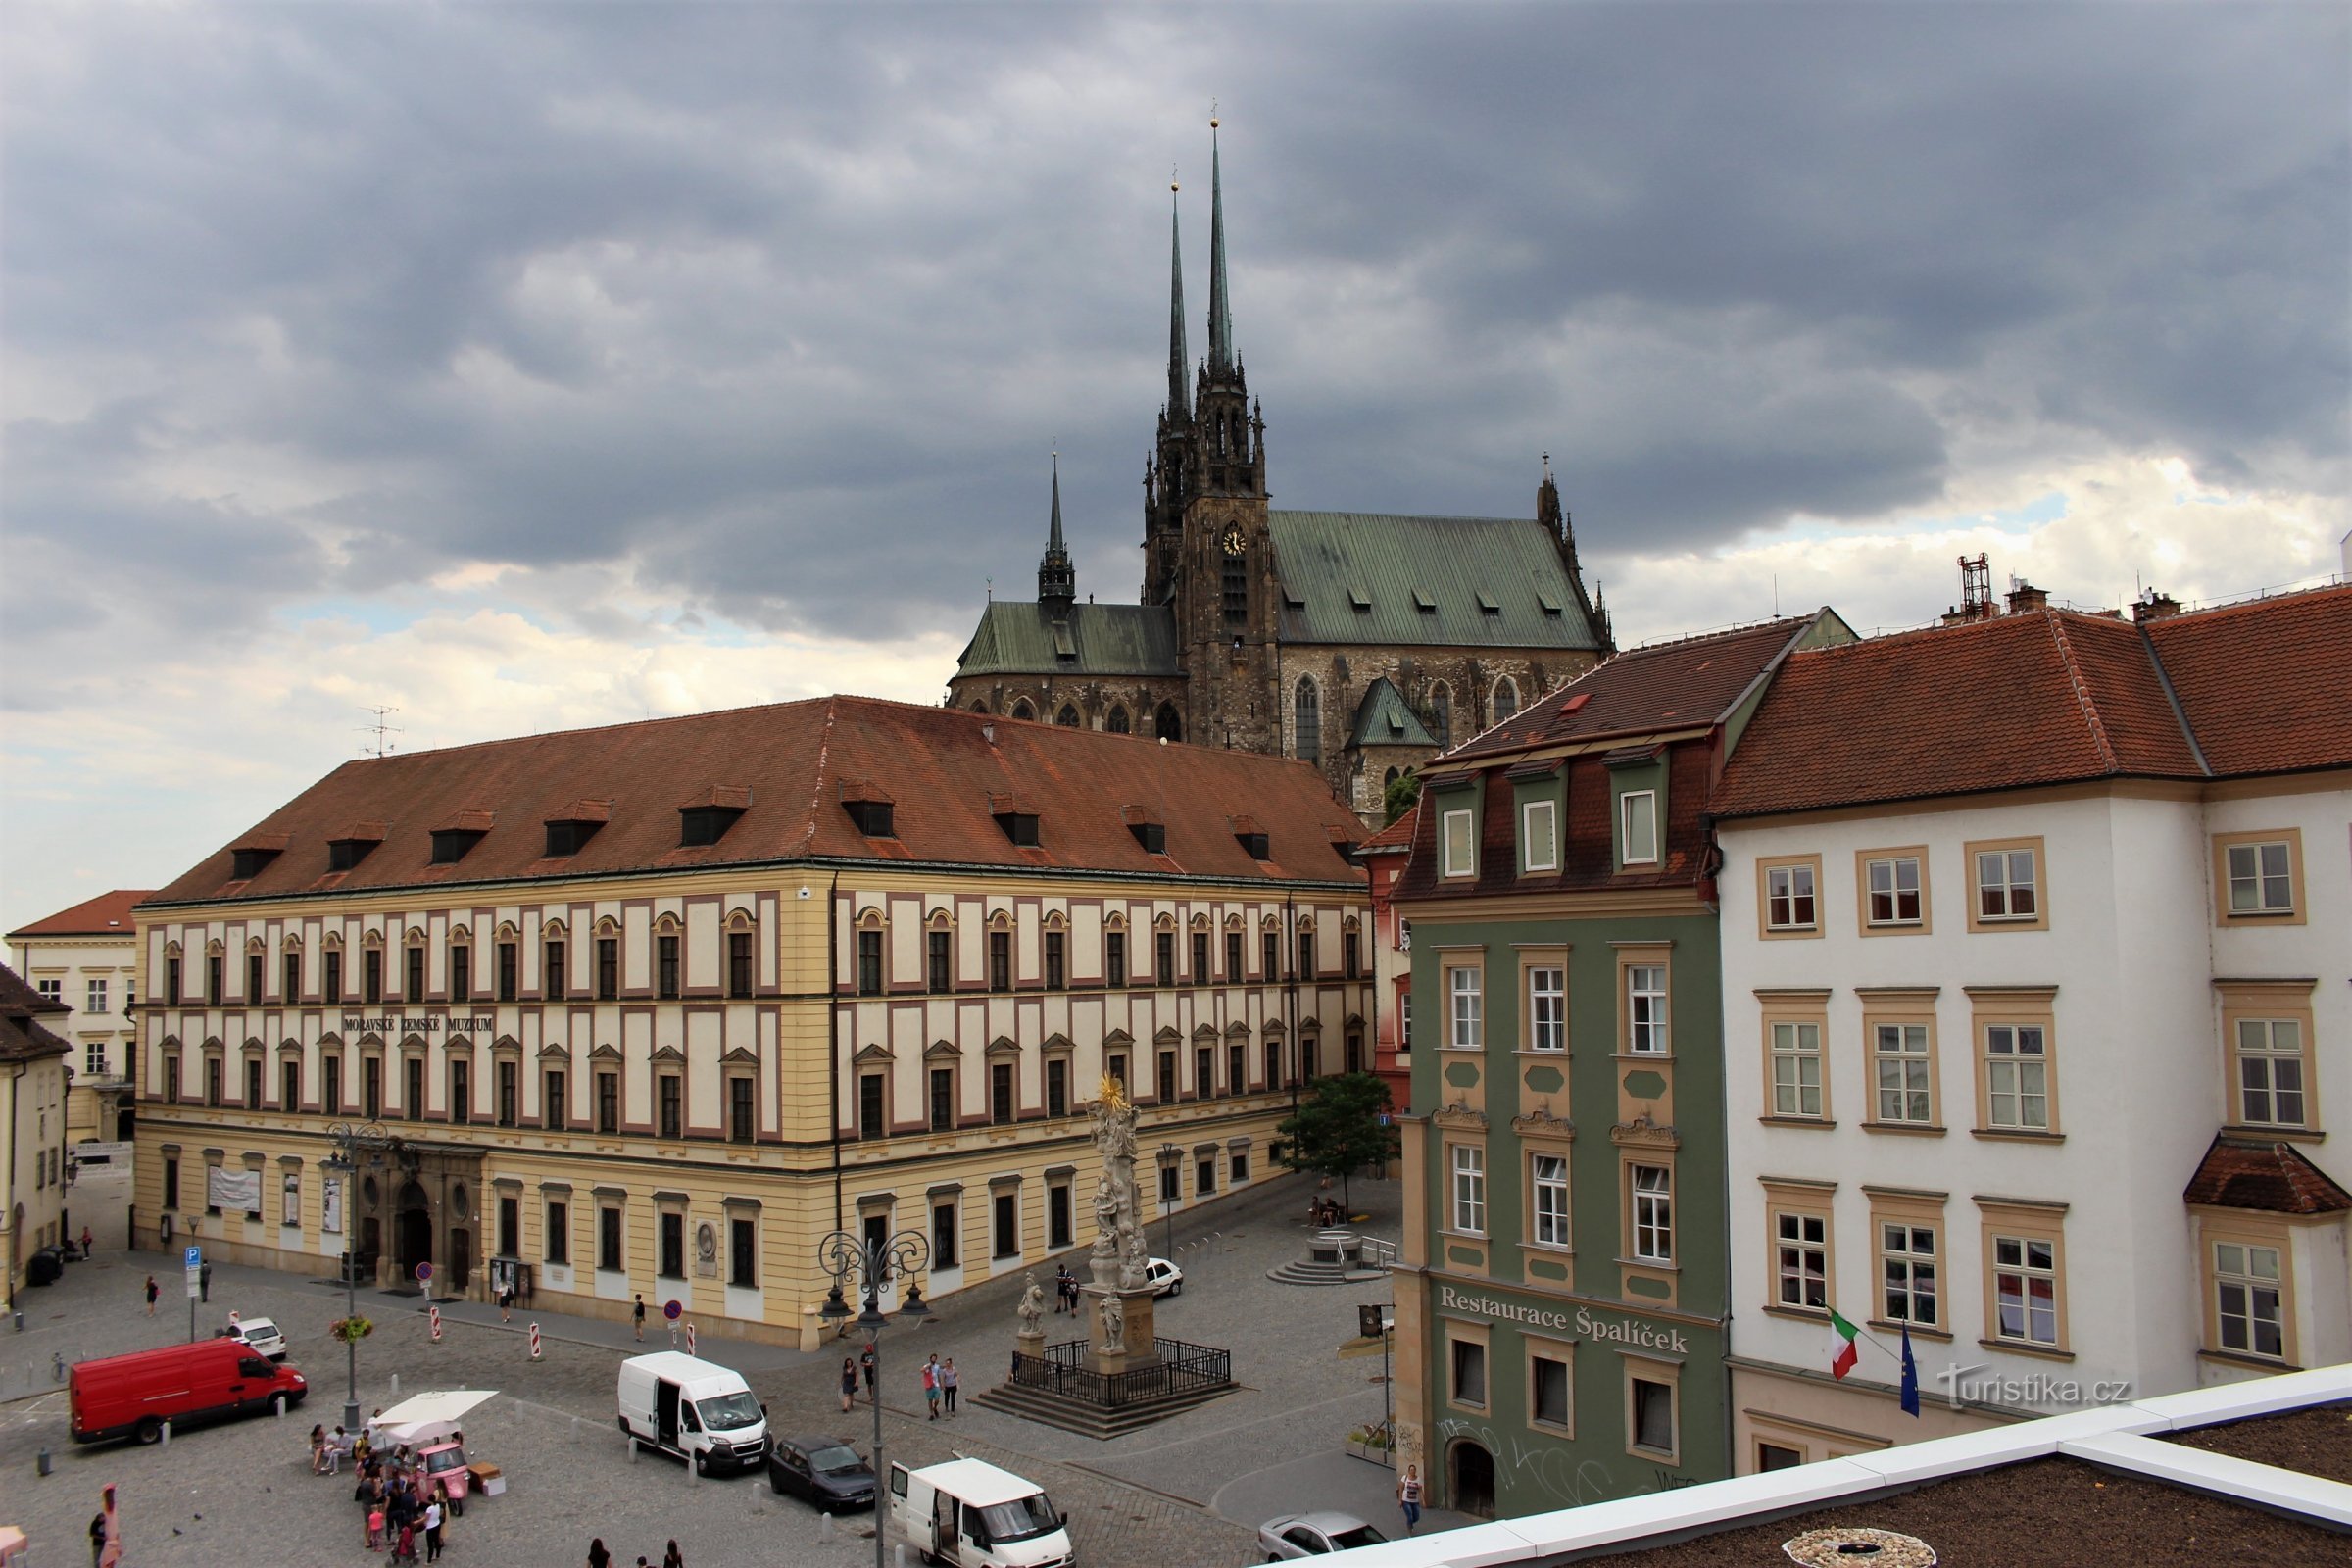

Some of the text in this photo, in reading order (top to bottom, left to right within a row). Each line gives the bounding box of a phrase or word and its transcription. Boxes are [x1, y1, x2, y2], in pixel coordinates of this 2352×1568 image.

[345, 1015, 493, 1032] MORAVSKÉ ZEMSKÉ MUZEUM
[1441, 1285, 1689, 1354] Restaurace Špalíček
